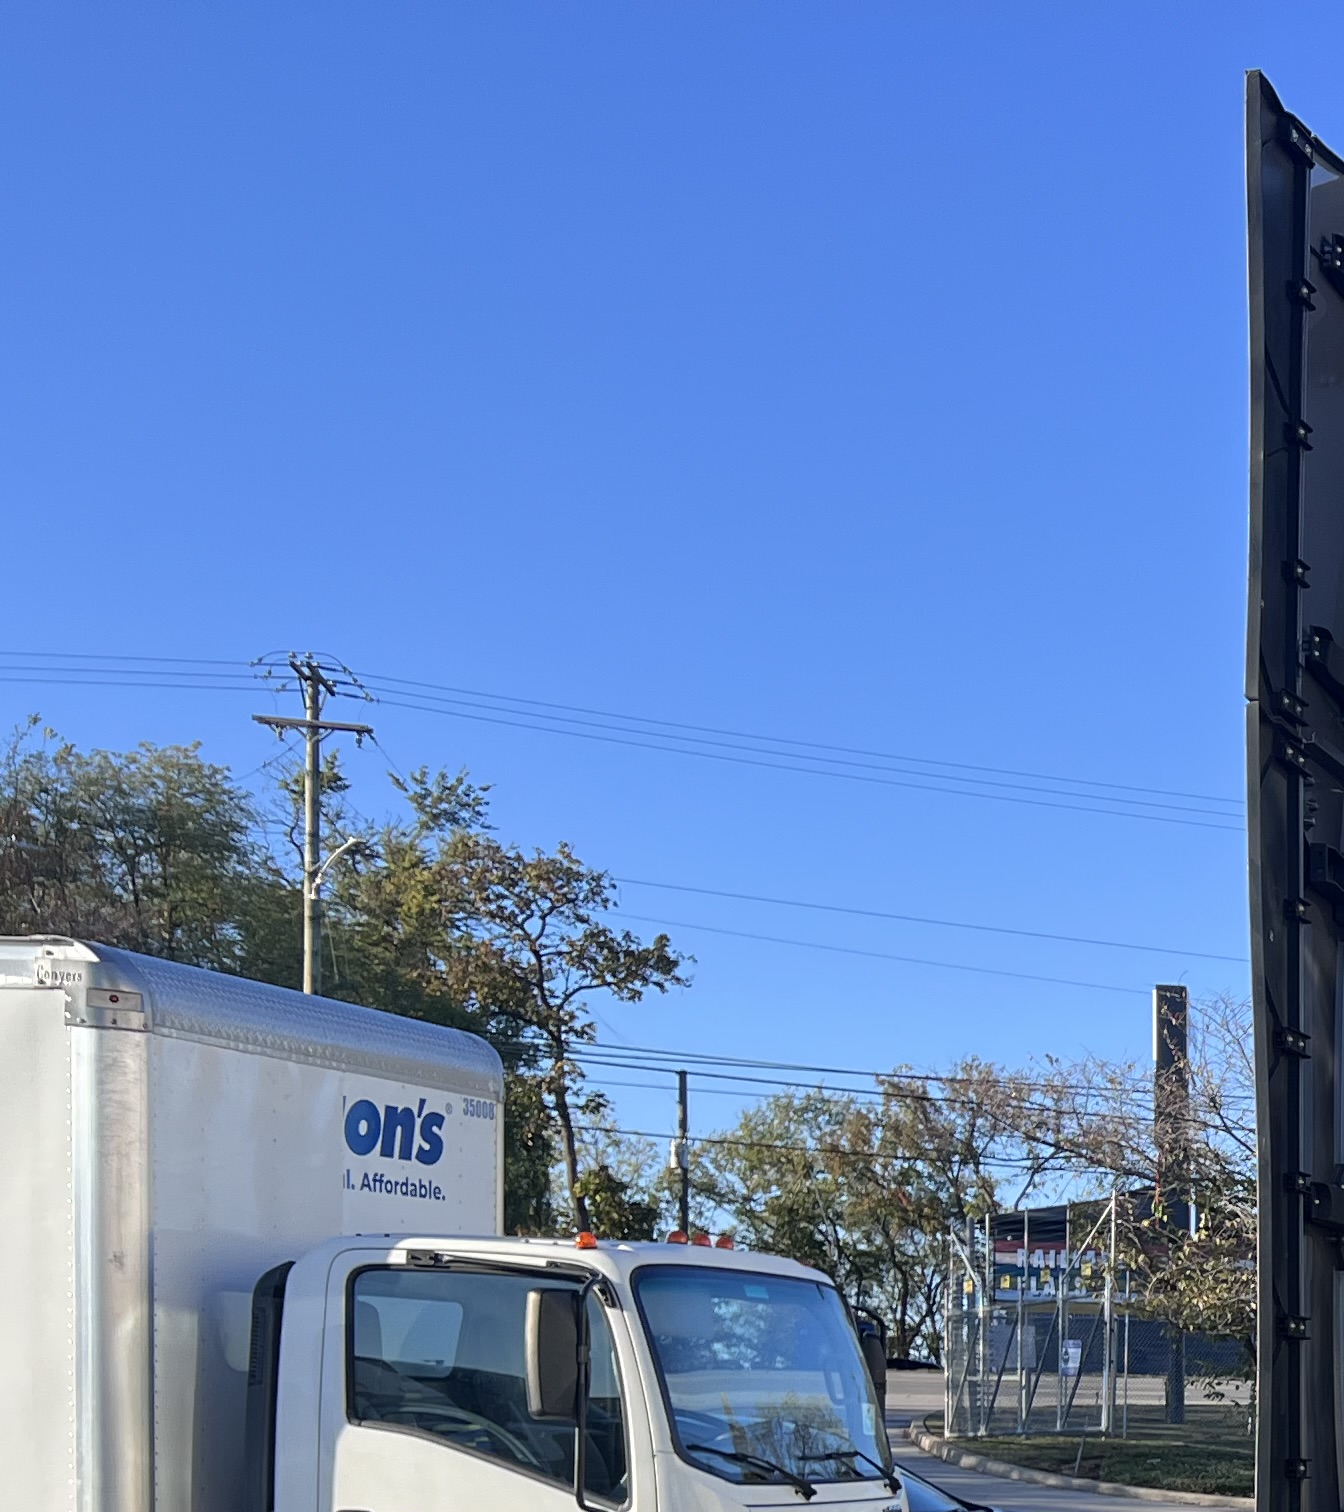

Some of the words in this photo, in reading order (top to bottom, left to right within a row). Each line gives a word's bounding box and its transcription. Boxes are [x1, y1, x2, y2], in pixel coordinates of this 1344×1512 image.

[463, 1097, 494, 1121] 35008
[343, 1096, 446, 1166] on's
[360, 1172, 446, 1202] Affordable.
